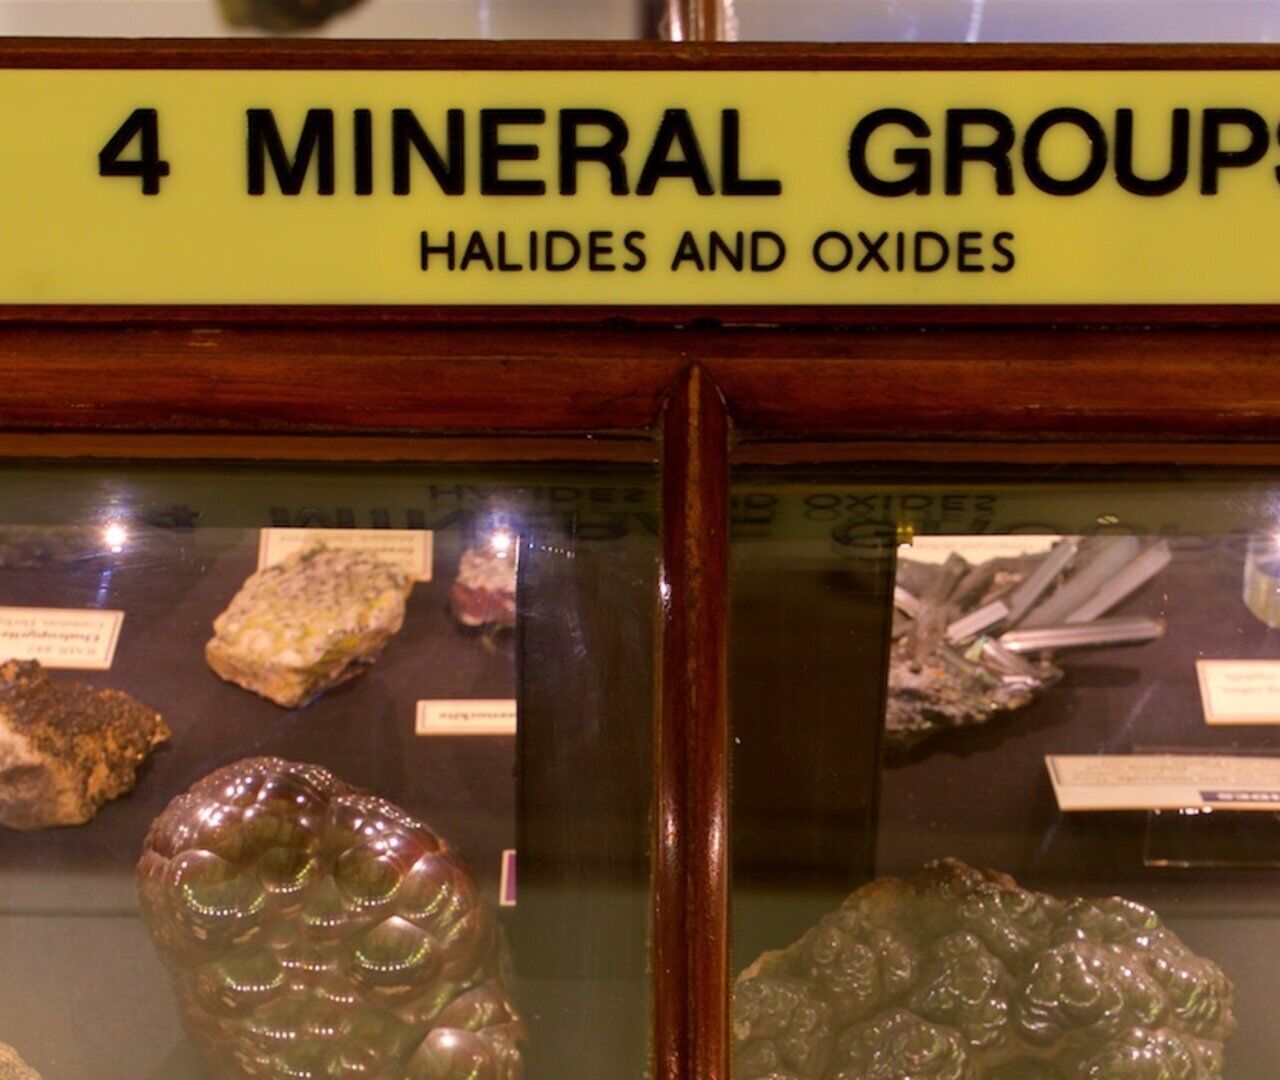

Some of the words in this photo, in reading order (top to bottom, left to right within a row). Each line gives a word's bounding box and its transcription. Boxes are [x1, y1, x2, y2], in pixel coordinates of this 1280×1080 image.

[98, 107, 170, 196] 4
[247, 107, 782, 197] MINERAL
[420, 231, 646, 273] HALIDES
[672, 231, 787, 273] AND
[812, 231, 1016, 273] OXIDES
